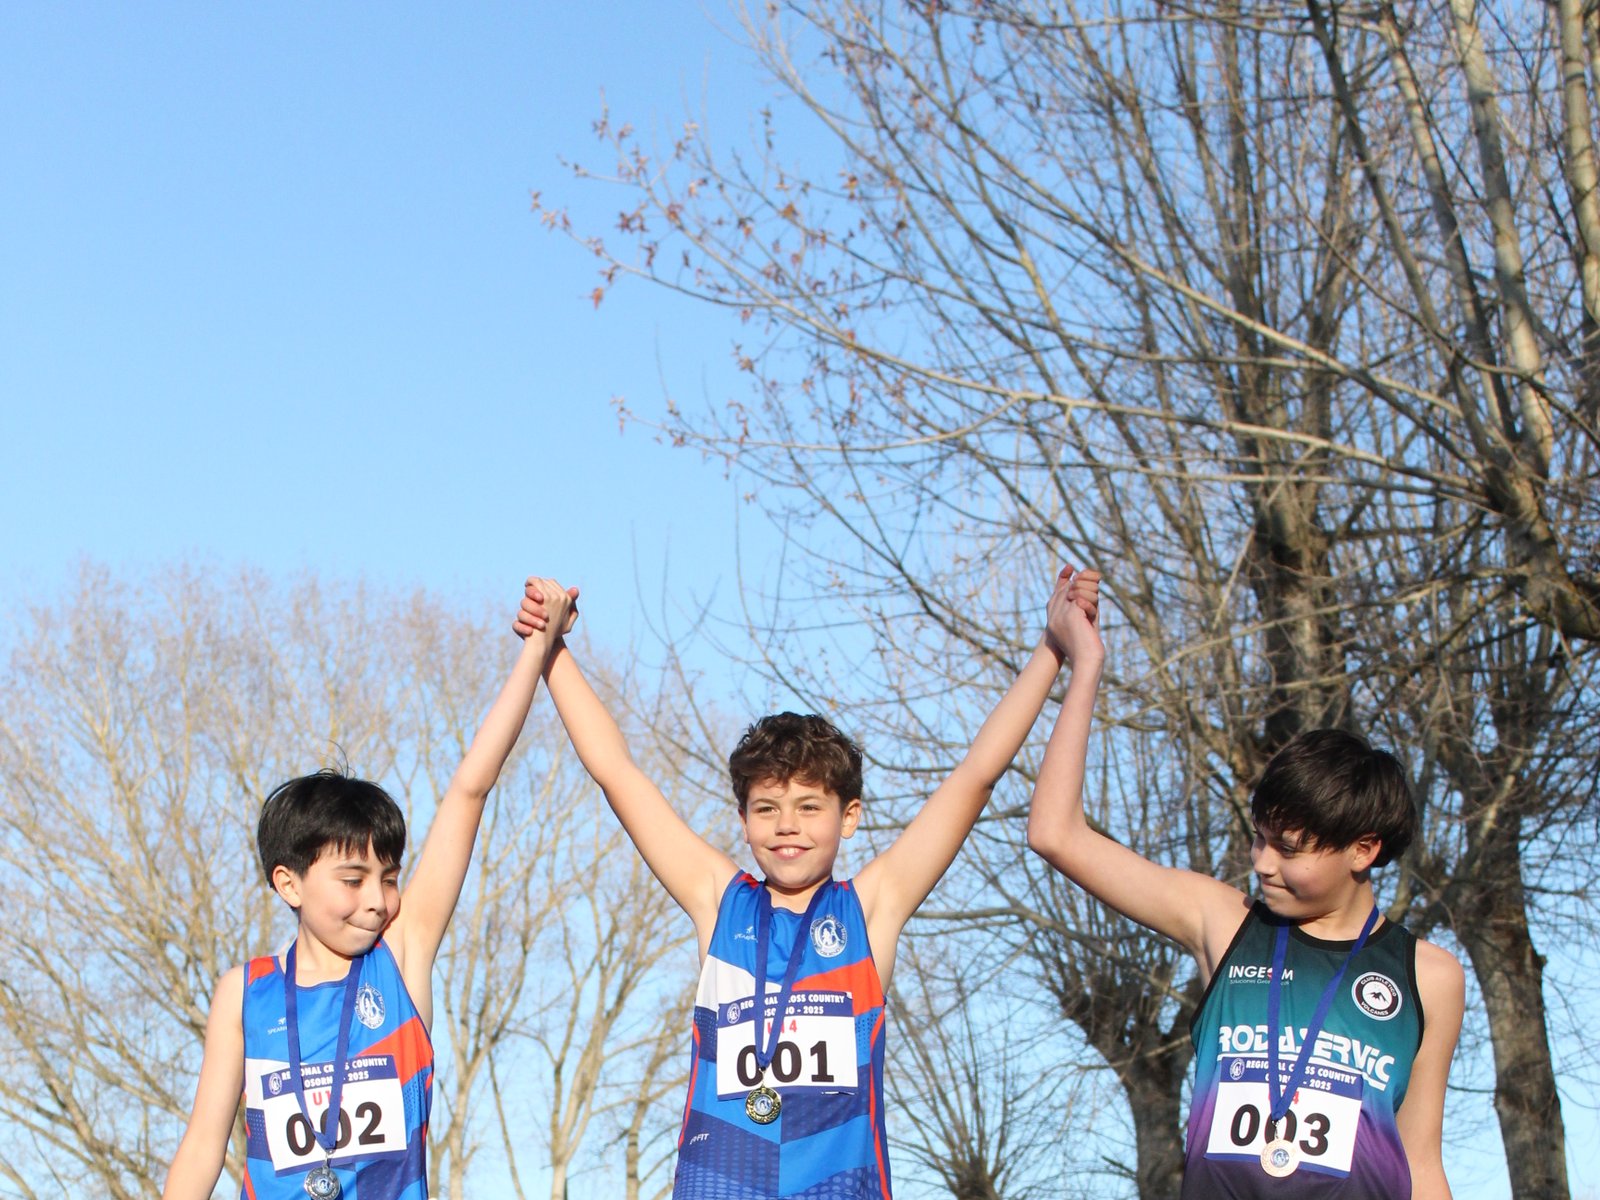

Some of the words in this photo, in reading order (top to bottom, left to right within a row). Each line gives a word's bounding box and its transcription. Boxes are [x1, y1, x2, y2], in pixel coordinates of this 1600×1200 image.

[808, 994, 845, 1004] COUNTRY
[803, 1006, 824, 1015] 2025
[323, 1062, 350, 1074] CRS
[351, 1057, 389, 1070] COUNTRY
[737, 1041, 834, 1087] 001
[304, 1076, 333, 1088] OSORN
[348, 1070, 370, 1082] 2025
[1288, 1063, 1316, 1075] CSS
[1317, 1068, 1357, 1085] COUNTRY
[1309, 1079, 1332, 1091] 2025
[286, 1102, 385, 1157] 002
[1231, 1104, 1330, 1156] 003
